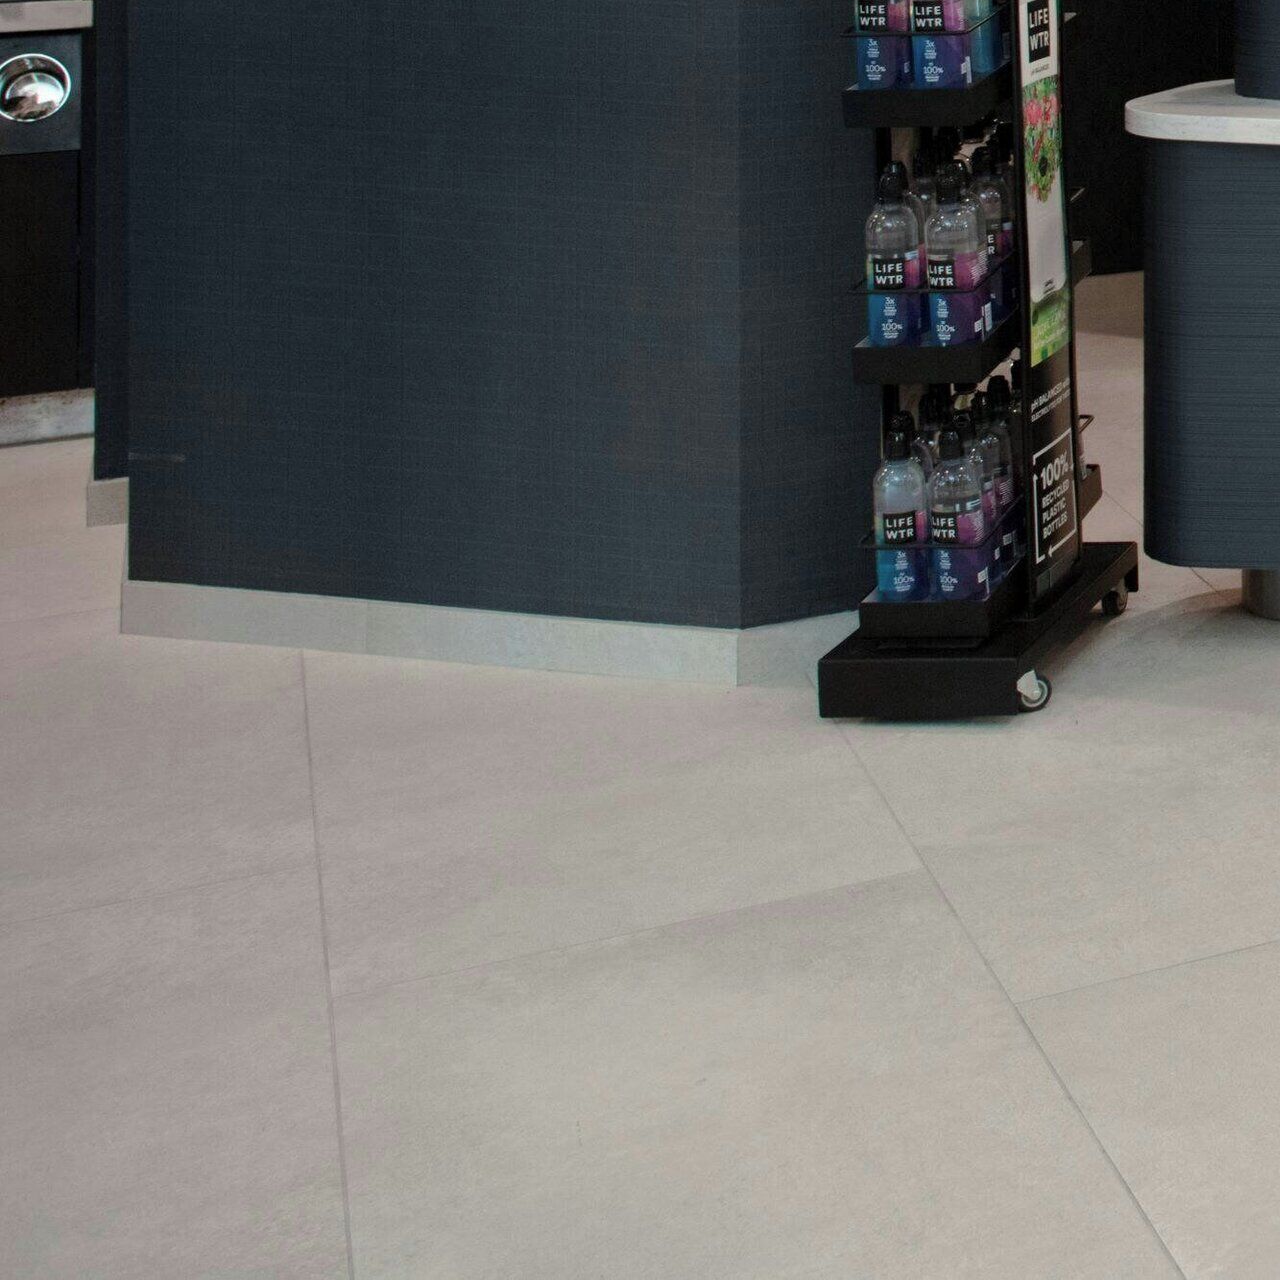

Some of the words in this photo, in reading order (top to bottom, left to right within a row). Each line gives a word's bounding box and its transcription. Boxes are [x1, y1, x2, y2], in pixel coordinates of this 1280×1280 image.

[860, 5, 886, 14] LIFE
[916, 6, 941, 15] LIFE
[860, 17, 886, 27] WTR
[915, 18, 942, 28] WTR
[1029, 8, 1048, 29] LIFE
[1029, 31, 1049, 51] WTR
[865, 64, 886, 72] 100%
[923, 66, 944, 74] 100%
[875, 263, 903, 273] LIFE
[929, 265, 953, 275] LIFE
[875, 275, 903, 284] WTR
[929, 277, 954, 286] WTR
[881, 322, 903, 330] 100%
[1041, 450, 1068, 490] 100%
[1042, 479, 1070, 509] RECYCLED
[1042, 497, 1067, 523] PLASTIC
[886, 516, 913, 528] LIFE
[932, 517, 954, 526] LIFE
[1043, 511, 1068, 539] BOTTLES
[886, 528, 914, 540] WTR
[932, 528, 956, 538] WTR
